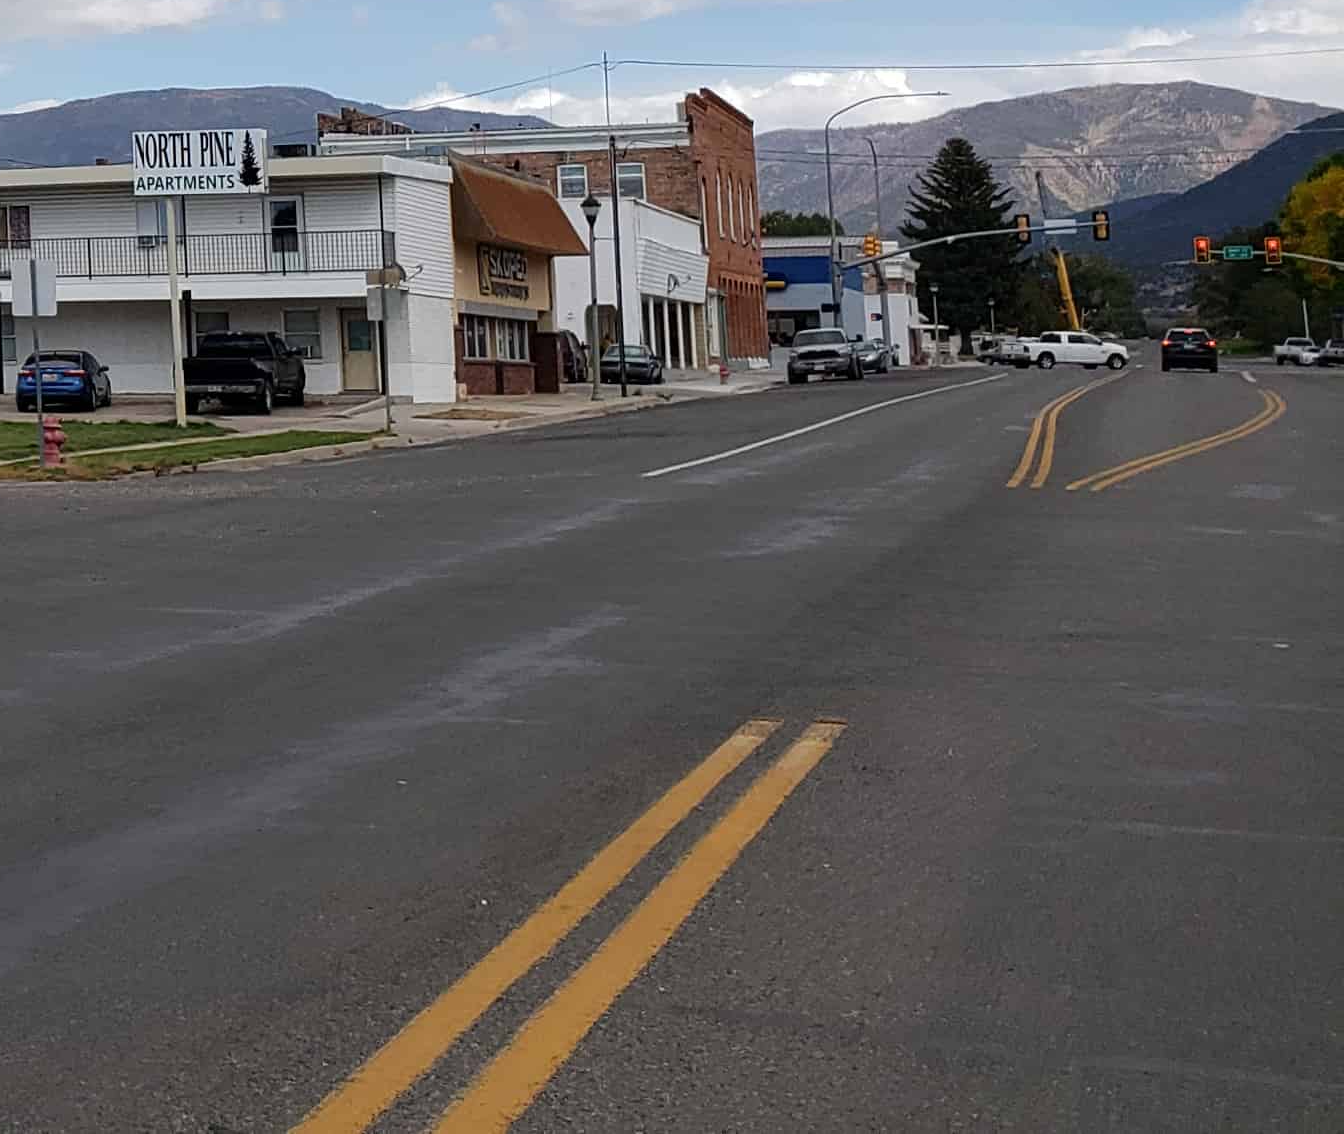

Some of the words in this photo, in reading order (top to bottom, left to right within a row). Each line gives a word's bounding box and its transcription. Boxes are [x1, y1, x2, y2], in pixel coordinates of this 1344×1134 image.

[134, 131, 191, 169] NORTH
[199, 130, 236, 168] PINE
[135, 174, 235, 191] APARTMENTS
